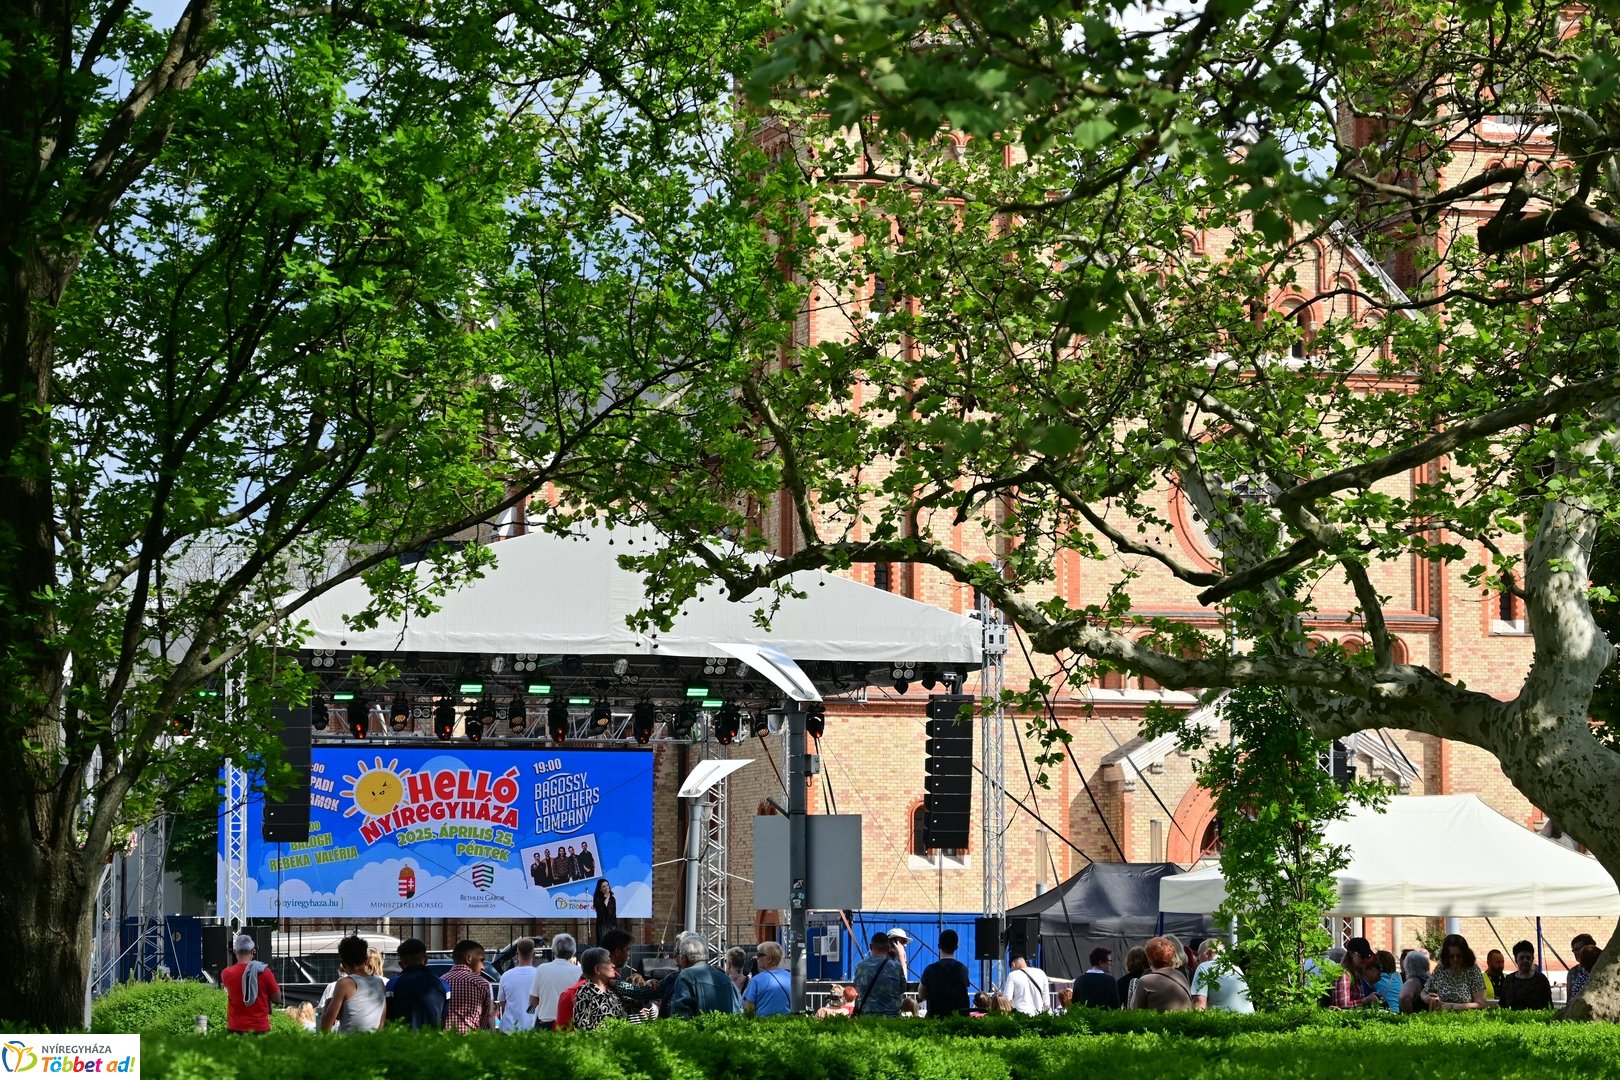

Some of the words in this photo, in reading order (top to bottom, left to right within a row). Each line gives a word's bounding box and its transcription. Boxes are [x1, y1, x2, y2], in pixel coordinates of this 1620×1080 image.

[533, 758, 562, 774] 19:00
[310, 776, 335, 793] PADI
[535, 772, 588, 801] BAGOSSY
[542, 788, 600, 816] BROTHERS
[535, 805, 591, 835] COMPANY
[396, 827, 437, 847] 2025.
[438, 822, 493, 842] ÁPRILIS
[494, 831, 516, 848] 25.
[269, 853, 312, 872] REBEKA
[313, 846, 359, 865] VALÉRIA
